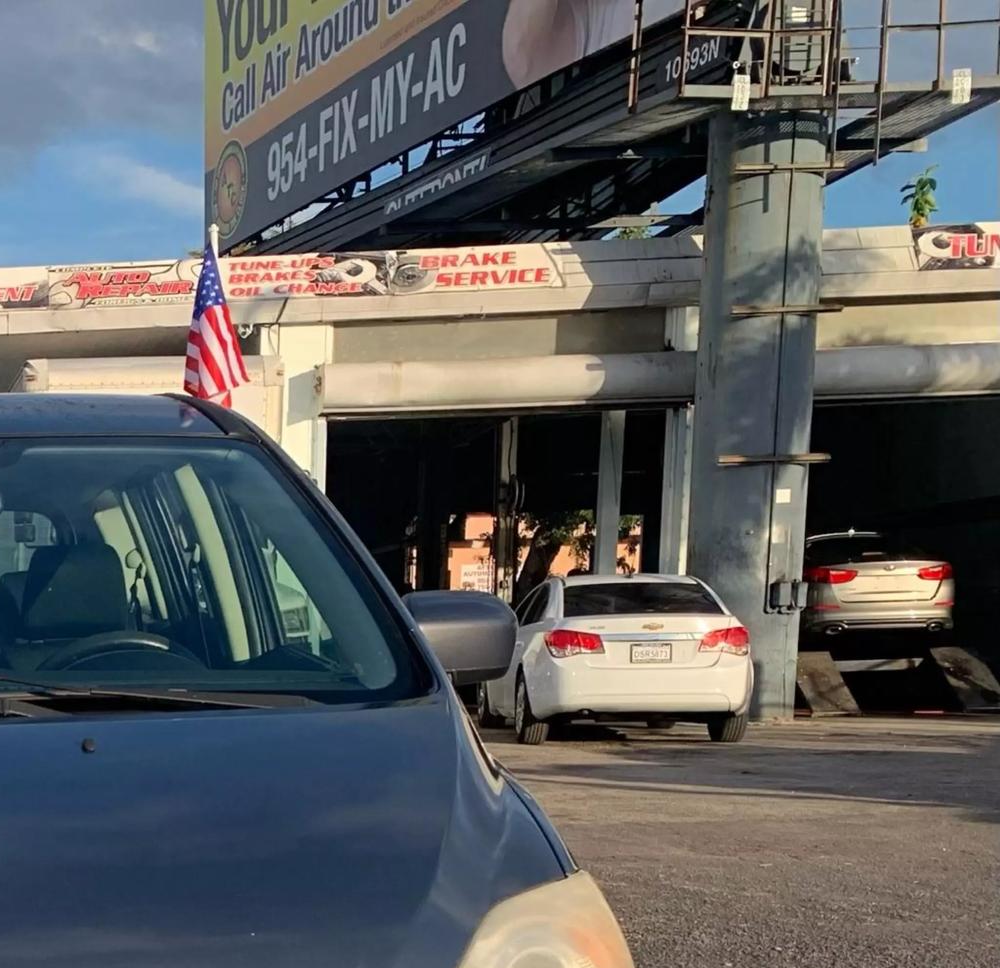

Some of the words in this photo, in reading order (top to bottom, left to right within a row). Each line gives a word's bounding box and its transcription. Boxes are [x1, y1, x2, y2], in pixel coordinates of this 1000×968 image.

[222, 64, 256, 130] Call
[262, 43, 290, 104] Air
[267, 23, 466, 201] 954-FIX-MY-AC
[228, 256, 336, 272] TUNE-UPS
[419, 251, 517, 270] BRAKE
[63, 271, 151, 286] AUTO
[228, 270, 318, 284] BRAKES
[435, 268, 550, 288] SERVICE
[76, 281, 193, 299] REPAIR
[229, 286, 265, 297] OIL
[273, 282, 362, 295] CHANGE
